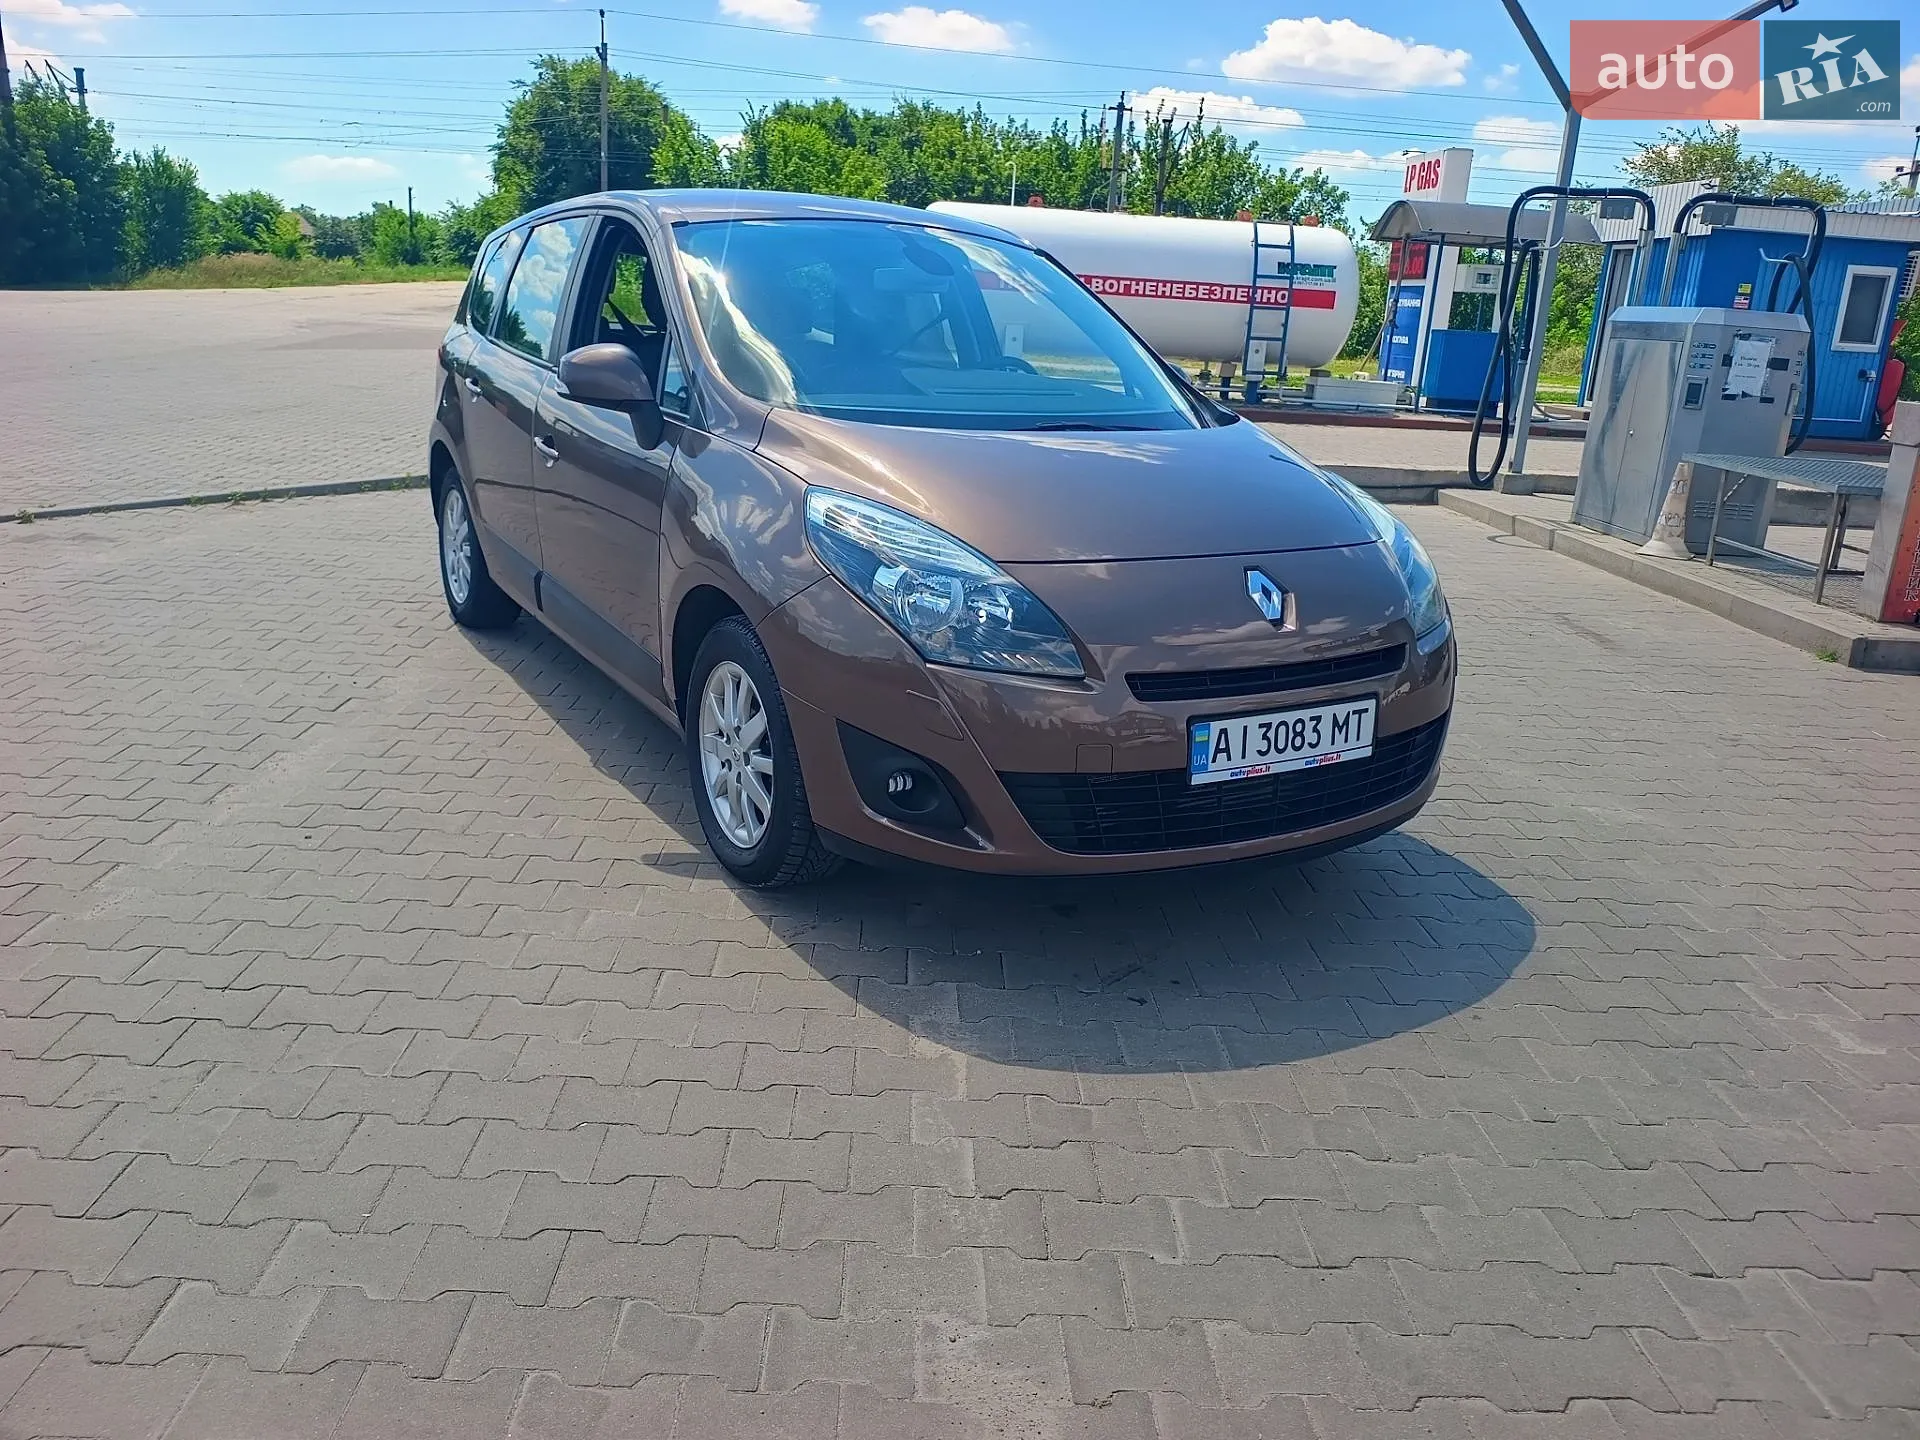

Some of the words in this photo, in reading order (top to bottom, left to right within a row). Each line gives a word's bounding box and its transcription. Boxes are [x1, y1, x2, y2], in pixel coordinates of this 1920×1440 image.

[1417, 158, 1441, 191] GAS
[1193, 754, 1207, 766] UA
[1256, 714, 1323, 757] 3083
[1330, 707, 1369, 746] MT
